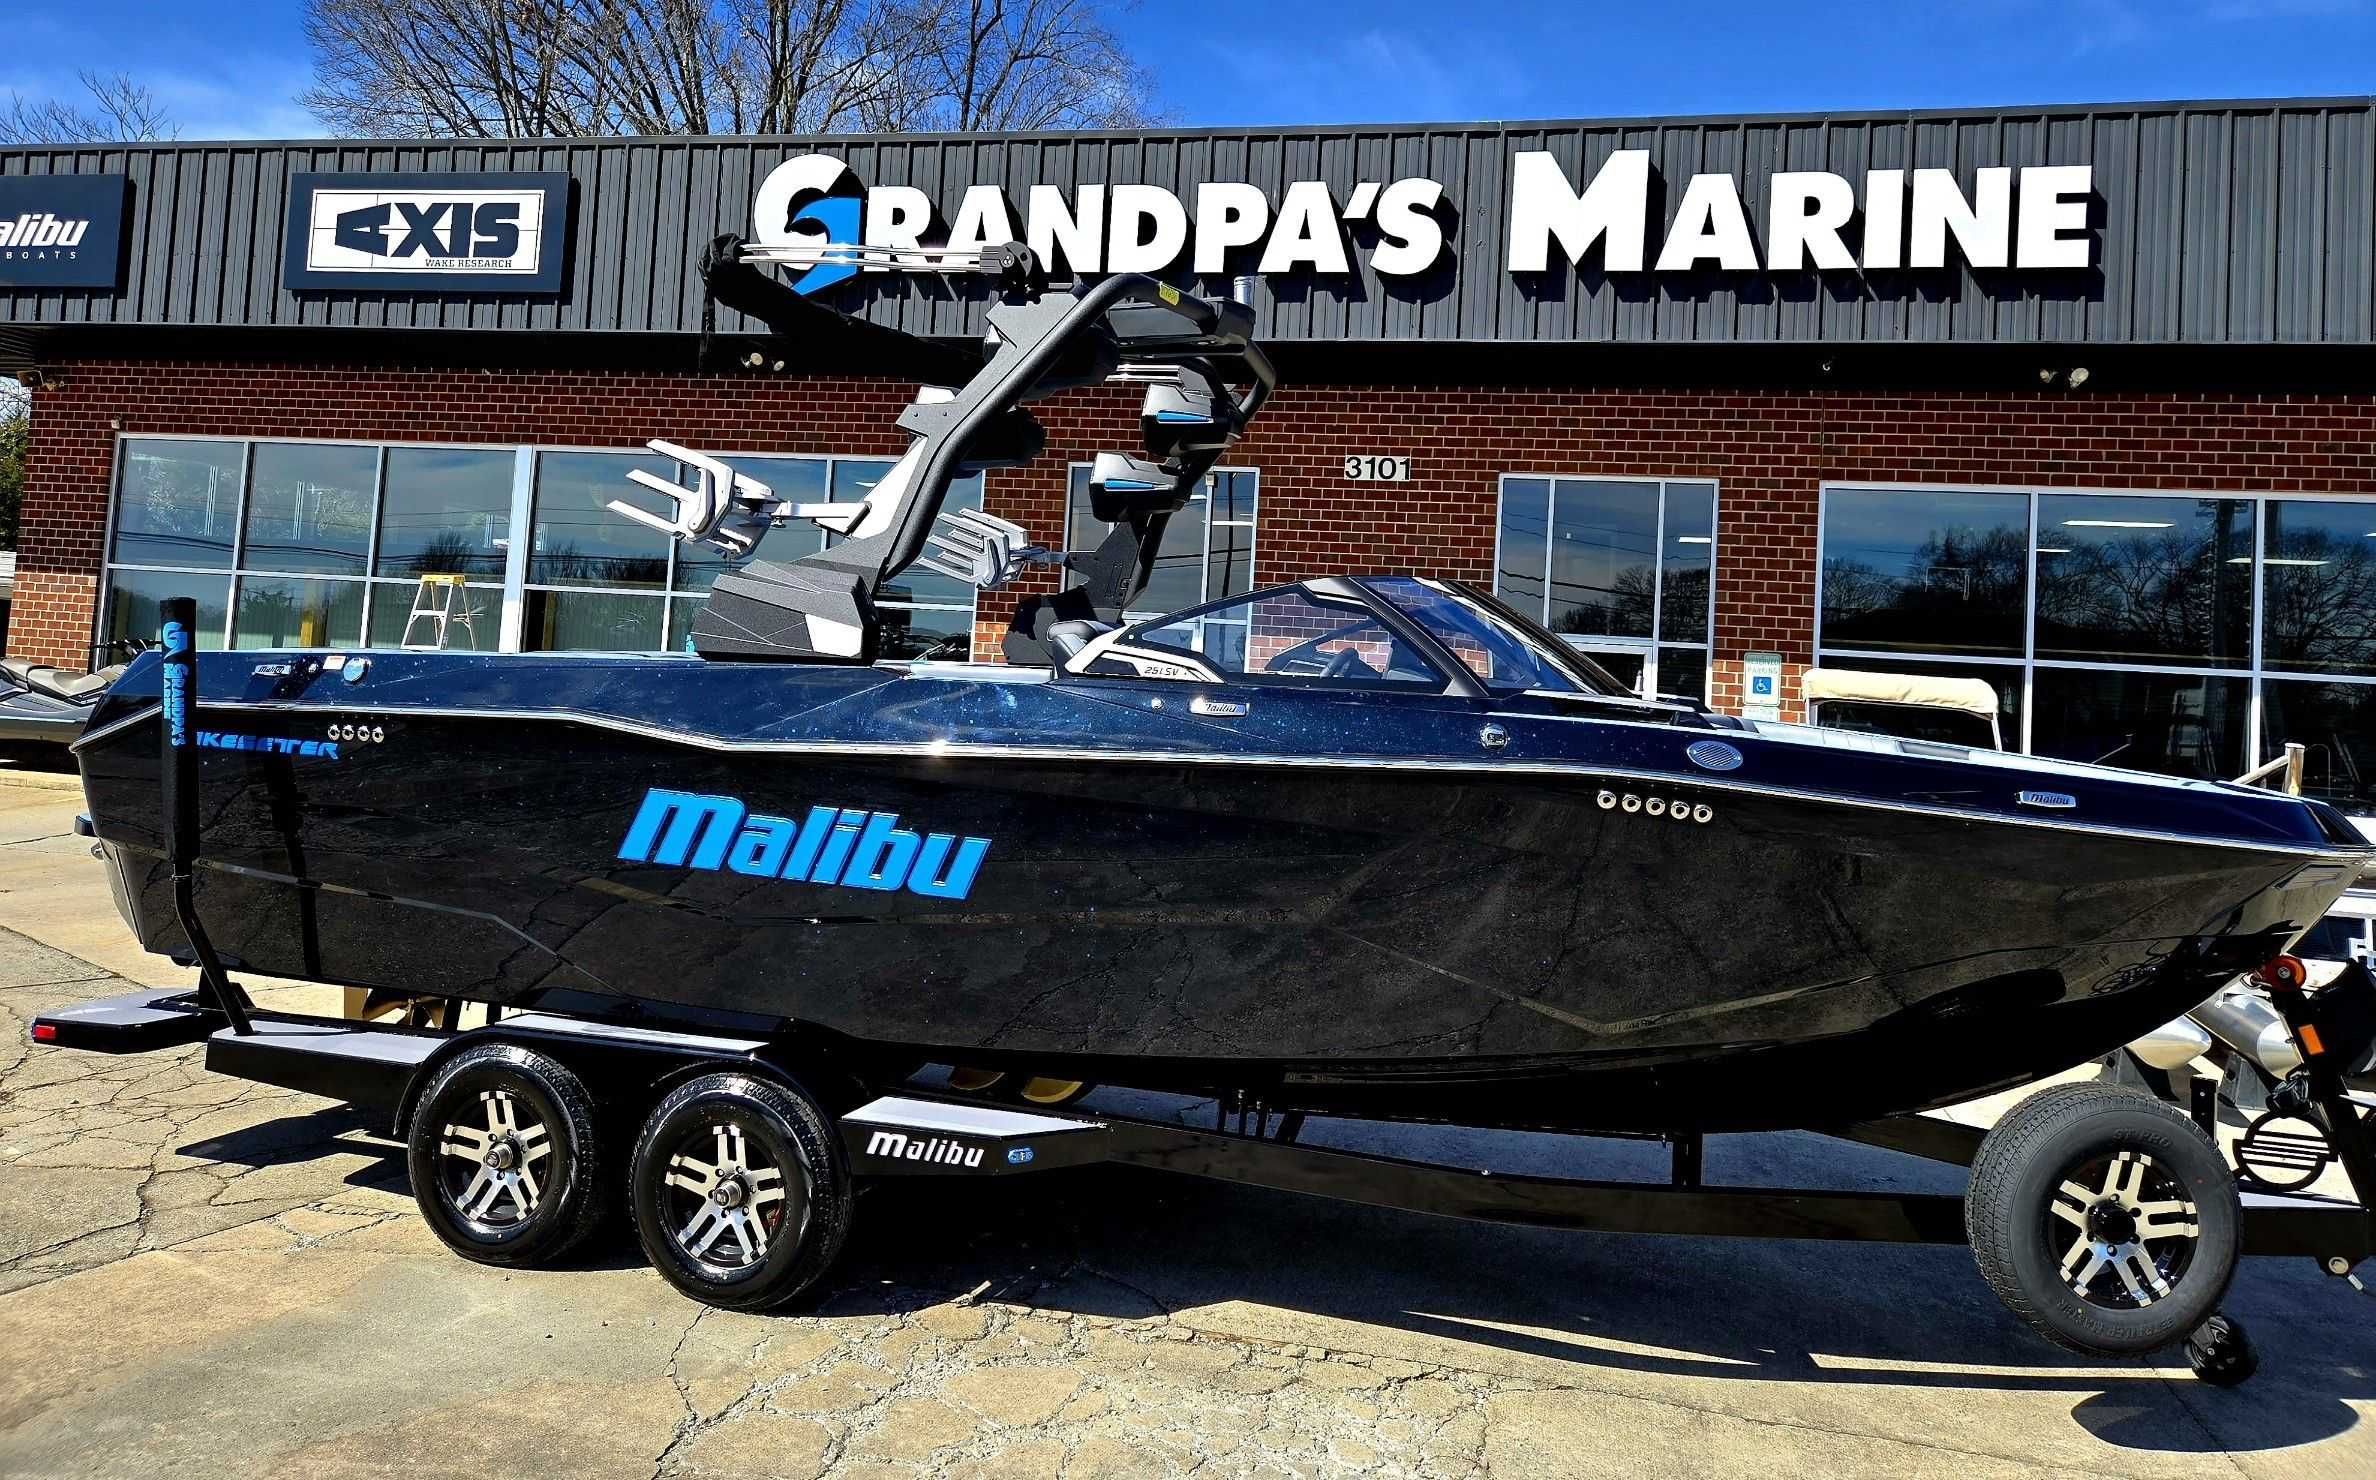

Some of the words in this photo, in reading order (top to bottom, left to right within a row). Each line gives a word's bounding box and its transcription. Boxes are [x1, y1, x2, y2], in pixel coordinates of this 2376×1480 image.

[1507, 149, 2093, 272] MARINE
[0, 213, 90, 247] alibu
[334, 202, 521, 258] AXIS
[6, 251, 77, 260] BOATS
[425, 258, 455, 268] WAKE
[457, 259, 513, 269] RESEARCH
[1345, 456, 1410, 481] 3101
[617, 787, 993, 900] Malibu
[866, 1131, 985, 1168] Malibu
